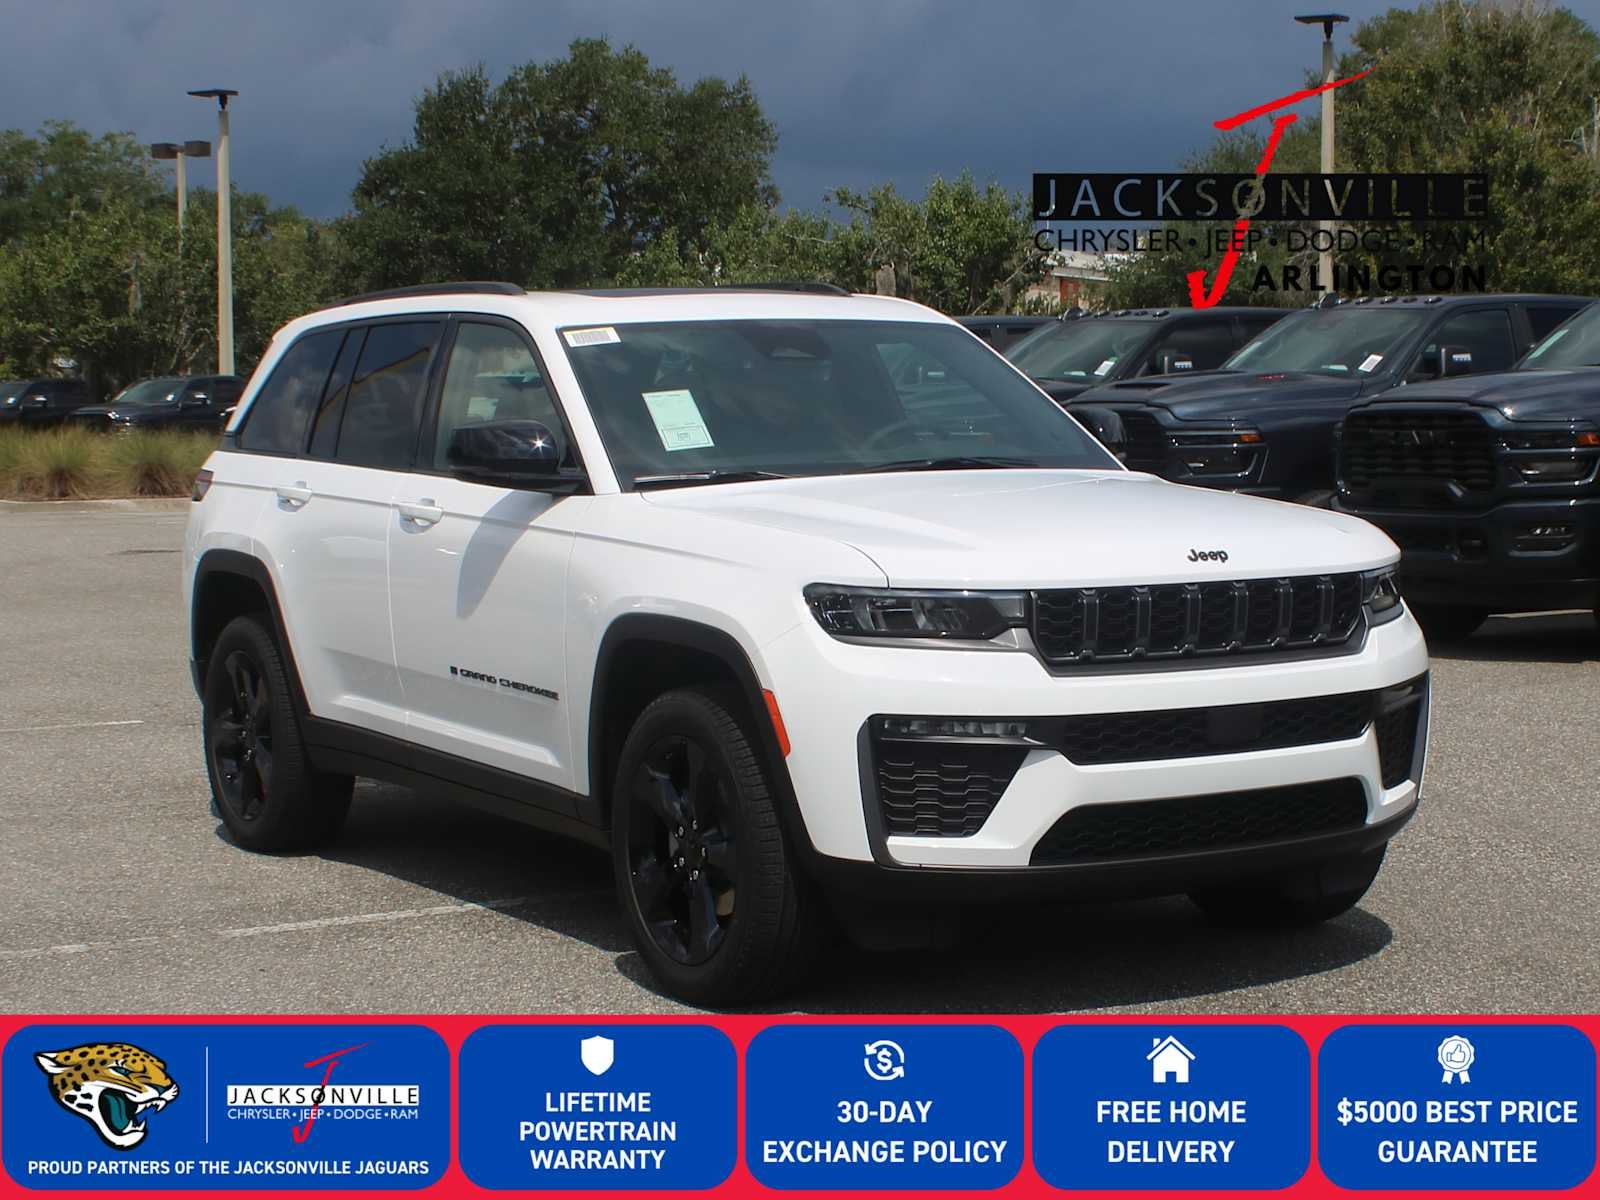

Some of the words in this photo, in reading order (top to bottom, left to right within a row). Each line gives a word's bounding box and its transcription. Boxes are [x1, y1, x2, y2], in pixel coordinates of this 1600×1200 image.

[1187, 548, 1229, 563] Jeep
[459, 668, 497, 684] GRAND
[498, 678, 560, 701] CHEROKEE
